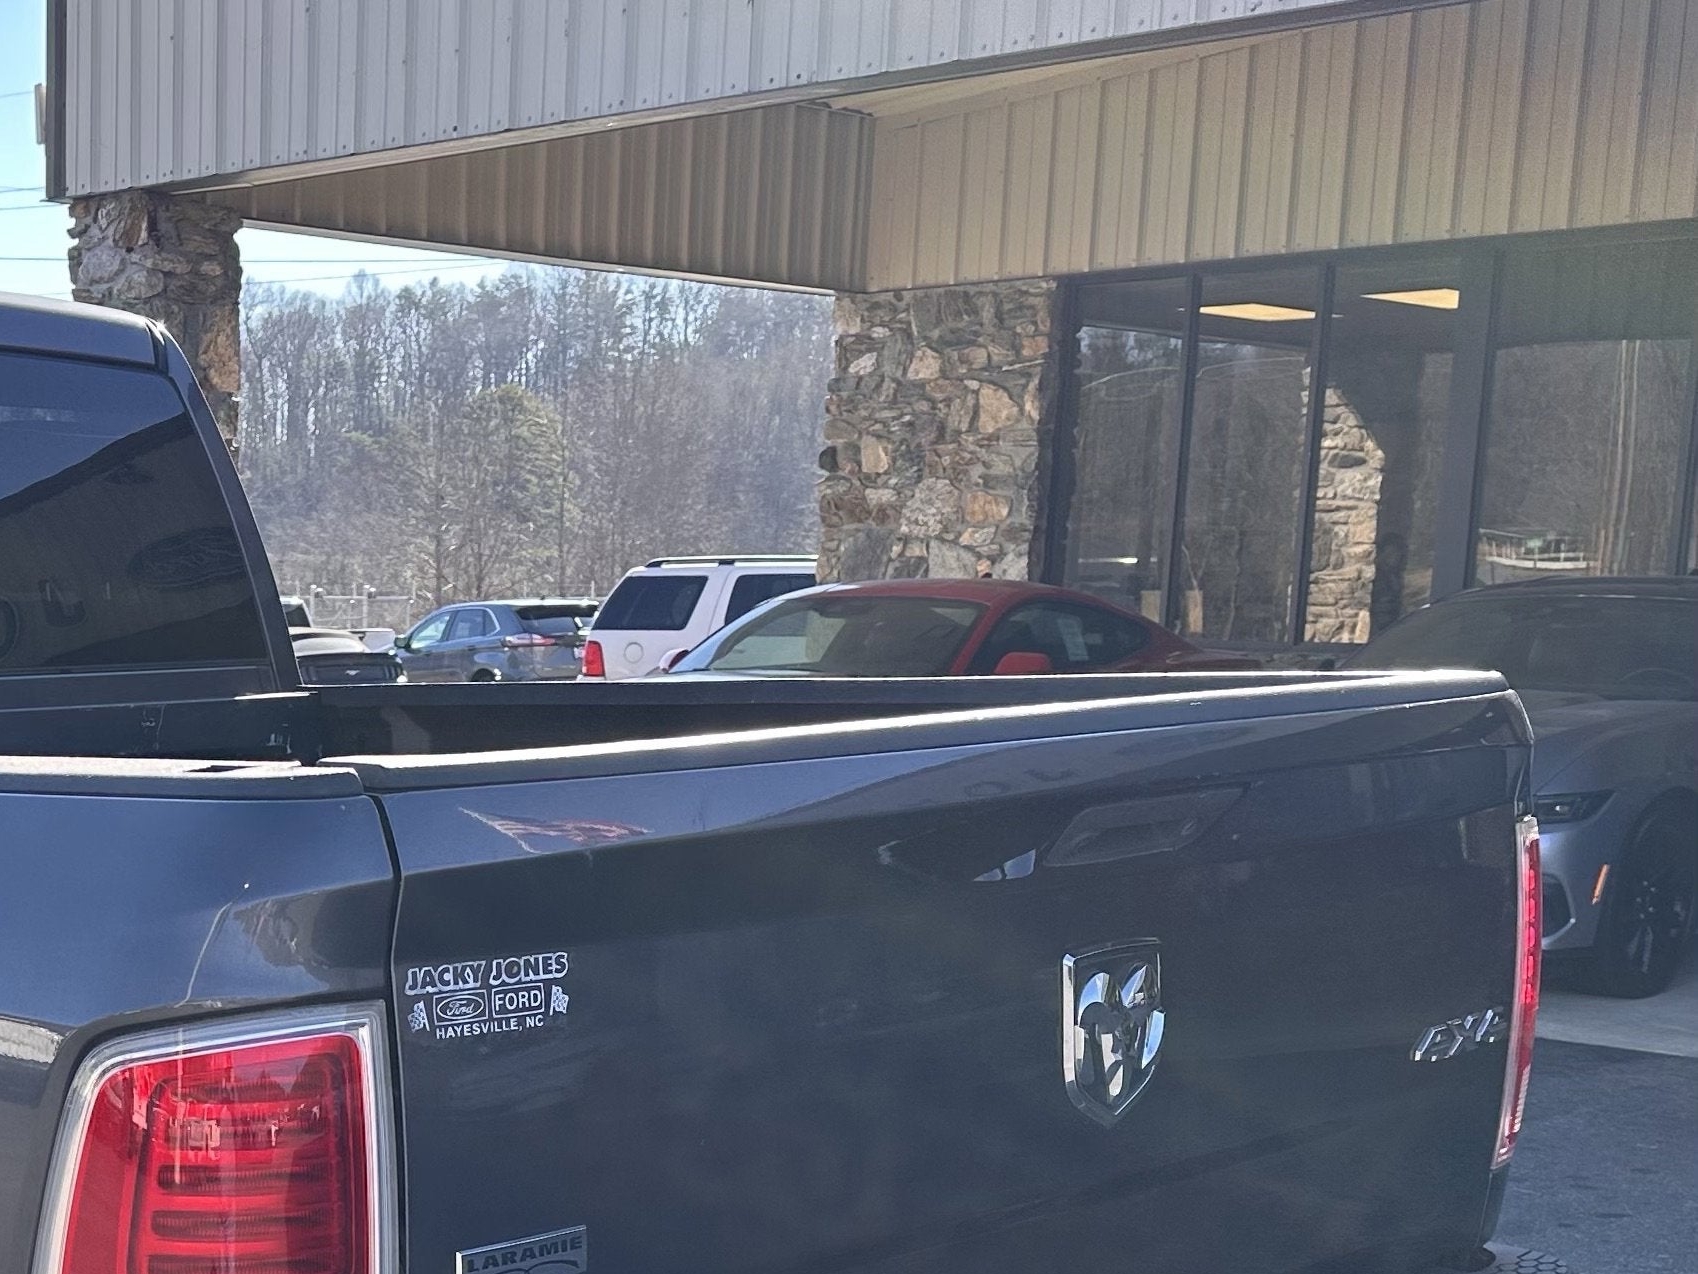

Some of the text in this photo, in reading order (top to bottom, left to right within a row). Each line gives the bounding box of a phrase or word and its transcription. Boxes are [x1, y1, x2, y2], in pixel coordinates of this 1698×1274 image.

[404, 951, 569, 996] JACKY JONES
[445, 989, 542, 1017] Ford FORD
[435, 1014, 545, 1040] HAYESVILLE, NC
[467, 1236, 583, 1273] LARAMIE
